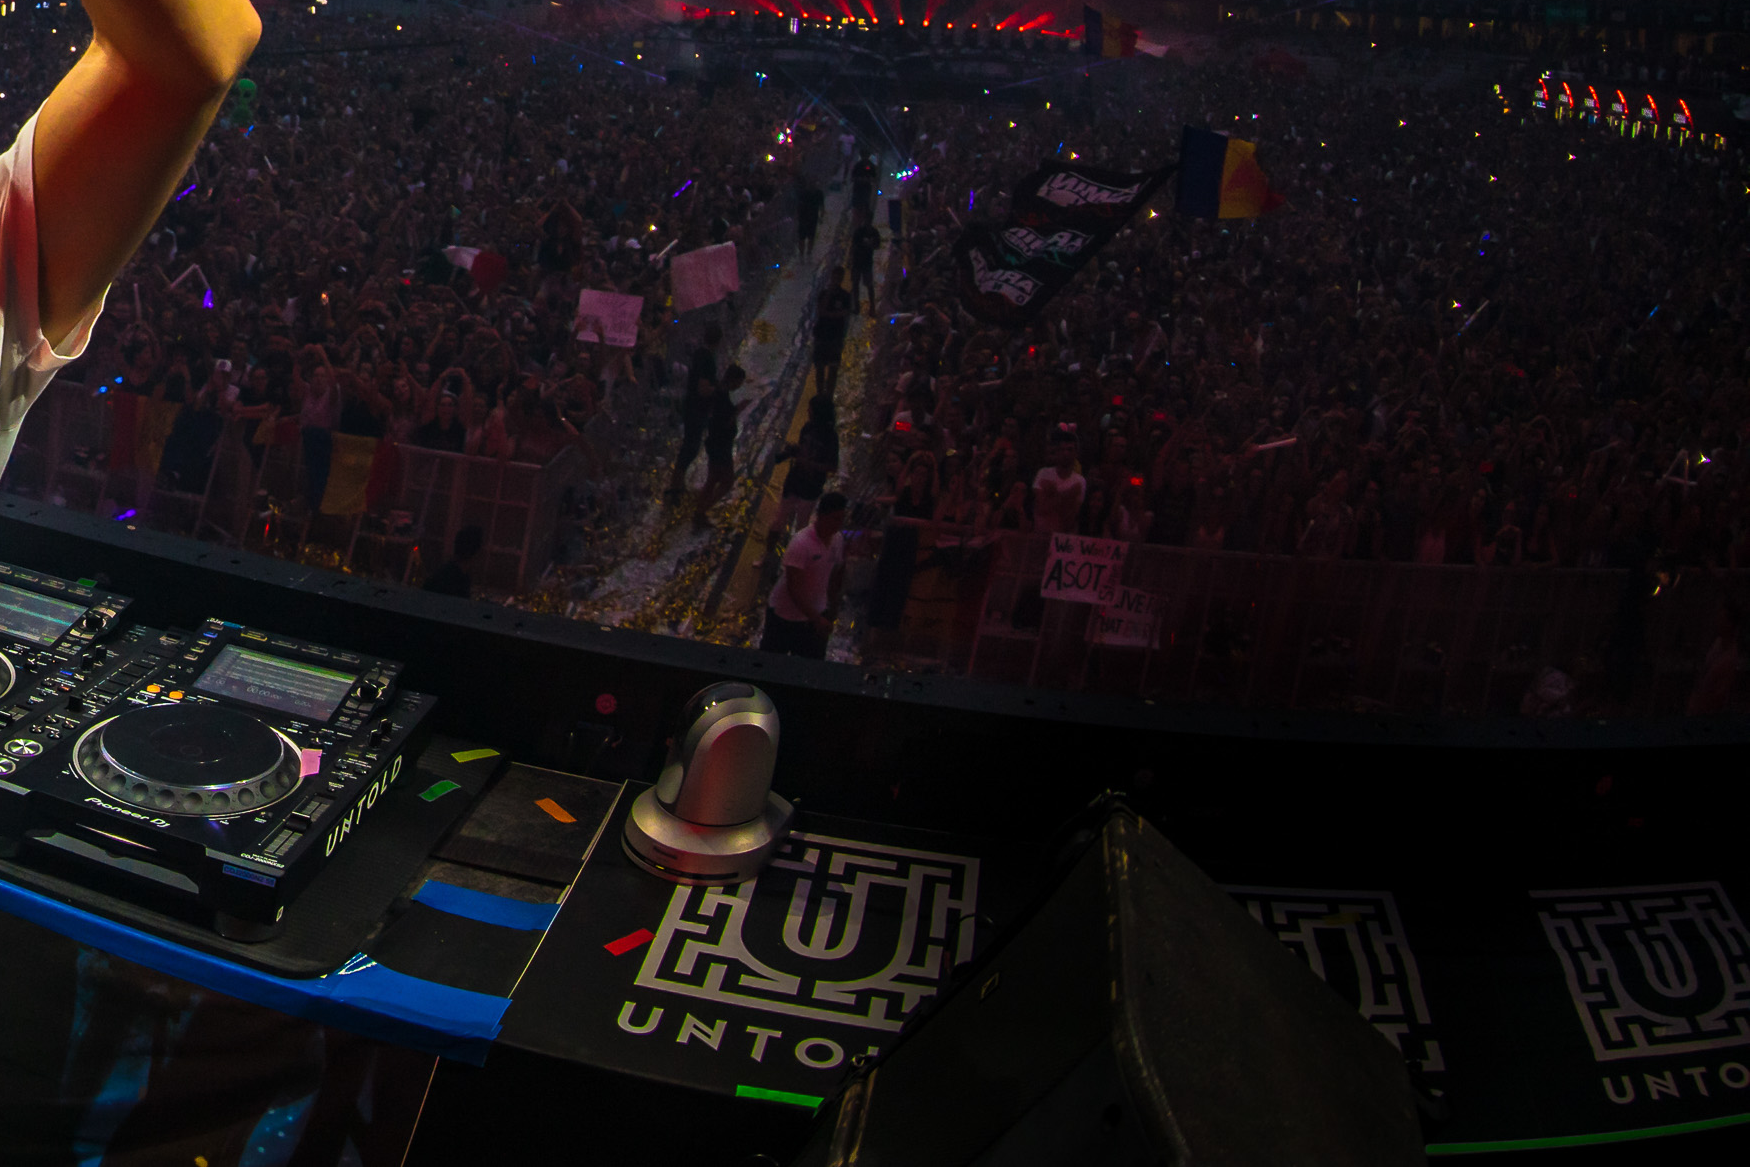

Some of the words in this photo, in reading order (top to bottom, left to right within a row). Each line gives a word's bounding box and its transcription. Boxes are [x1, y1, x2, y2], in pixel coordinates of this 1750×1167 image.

[1044, 559, 1107, 591] ASOT
[84, 797, 150, 820] Pioneer
[325, 754, 403, 858] UNTOLD
